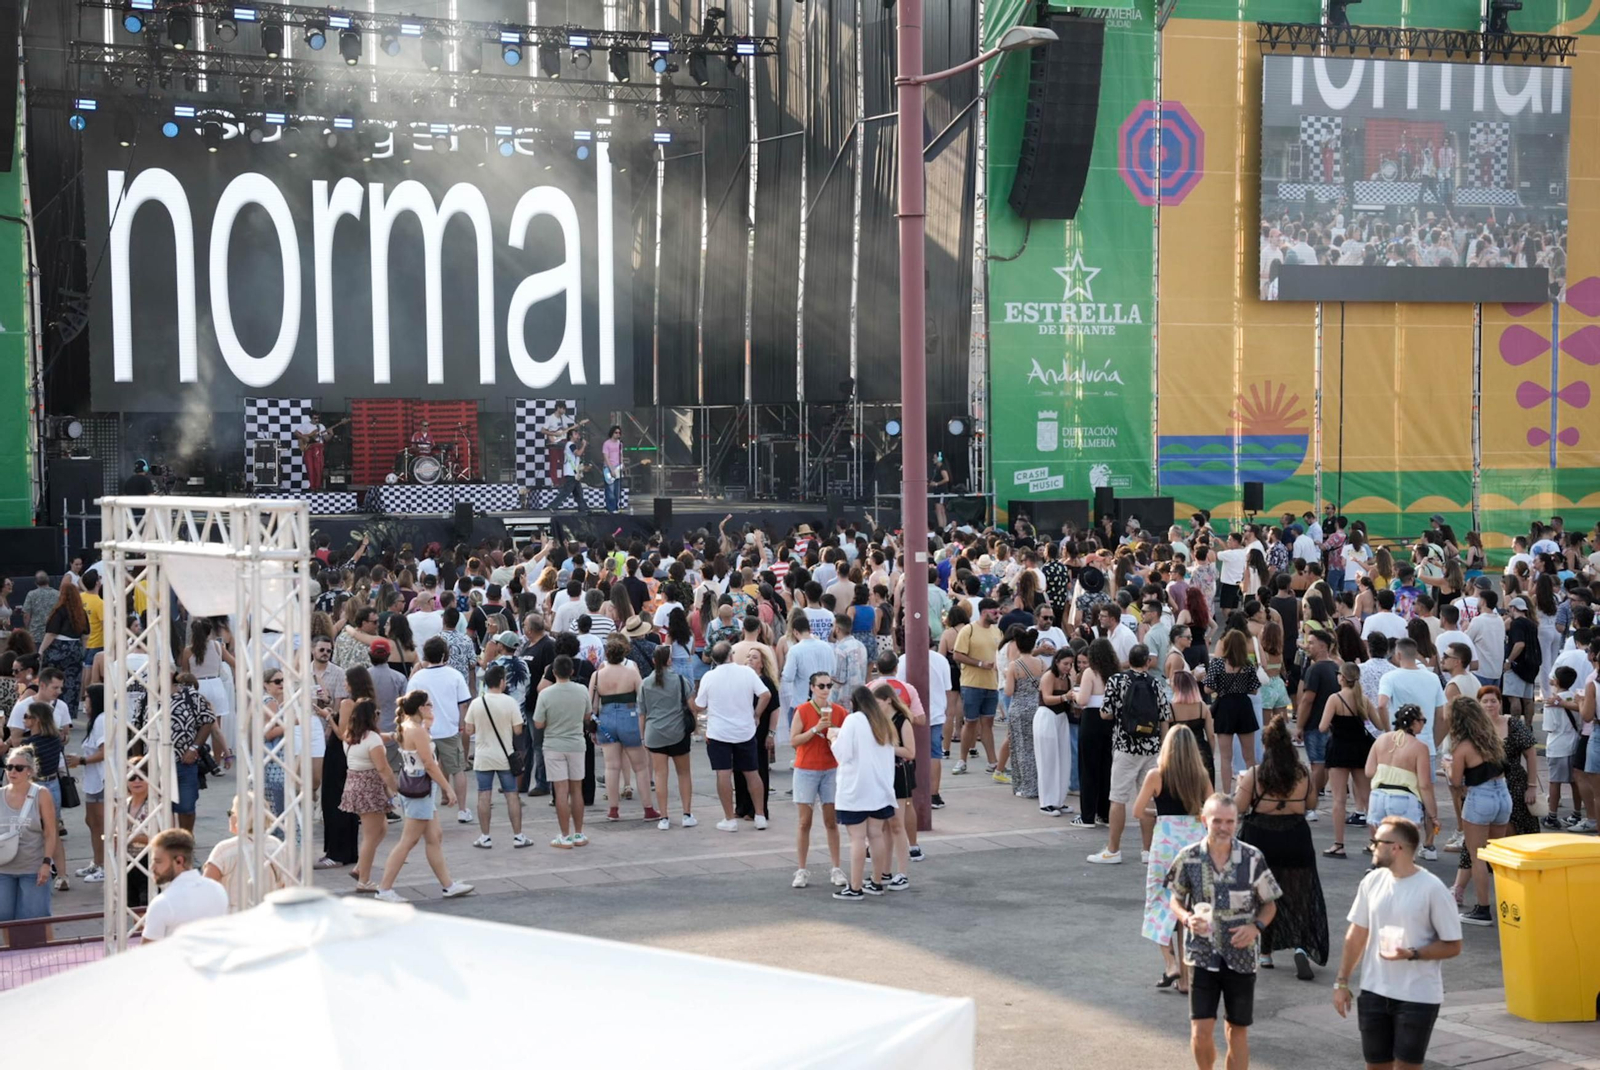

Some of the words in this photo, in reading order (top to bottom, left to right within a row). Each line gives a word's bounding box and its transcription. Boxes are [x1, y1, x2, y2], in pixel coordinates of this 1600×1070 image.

[106, 119, 616, 387] normal
[1004, 302, 1143, 324] ESTRELLA
[1038, 325, 1057, 335] DE
[1059, 325, 1116, 335] LEVANTE
[1027, 358, 1125, 386] Andalucía
[1062, 425, 1118, 436] DIPUTACIÓN
[1063, 438, 1076, 448] DE
[1079, 437, 1116, 448] ALMERÍA
[1016, 470, 1046, 481] CRASH
[1032, 479, 1060, 491] MUSIC
